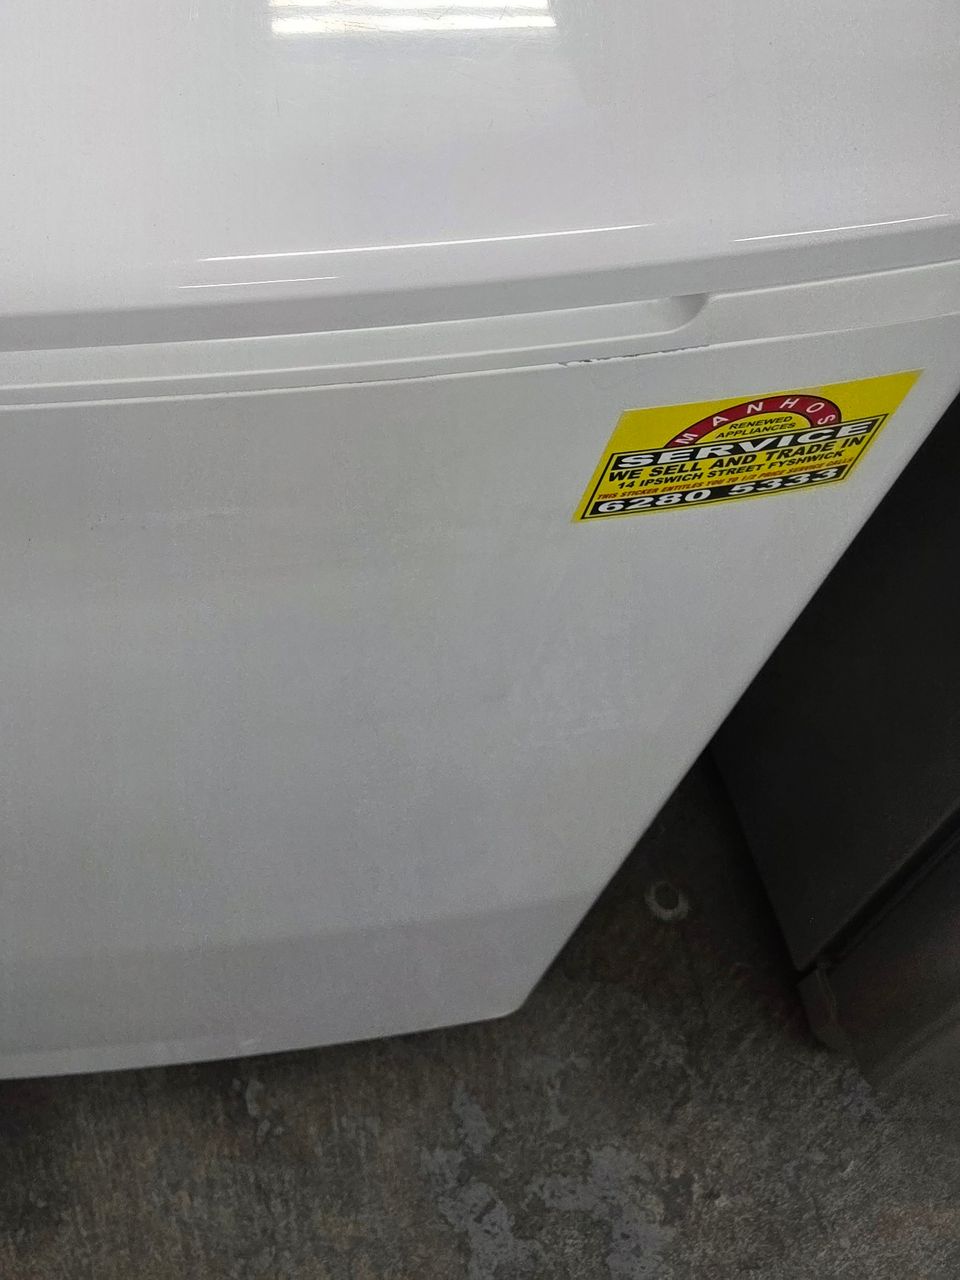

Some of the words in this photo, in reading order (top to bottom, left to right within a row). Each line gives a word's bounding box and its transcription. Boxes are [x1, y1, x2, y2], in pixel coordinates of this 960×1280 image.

[716, 423, 796, 439] APPLIANCES
[729, 416, 793, 430] RENEWED
[609, 469, 643, 482] WE
[649, 462, 702, 476] SELL
[708, 454, 757, 469] AND
[766, 441, 835, 461] TRADE
[841, 436, 866, 448] IN
[621, 421, 872, 468] SERVICE
[618, 480, 636, 489] 14
[639, 472, 703, 487] IPSWICH
[707, 464, 766, 478] STREET
[768, 450, 844, 469] FYSHWICK
[598, 489, 711, 512] 6280
[728, 468, 839, 496] 5333
[620, 488, 658, 497] STICKER
